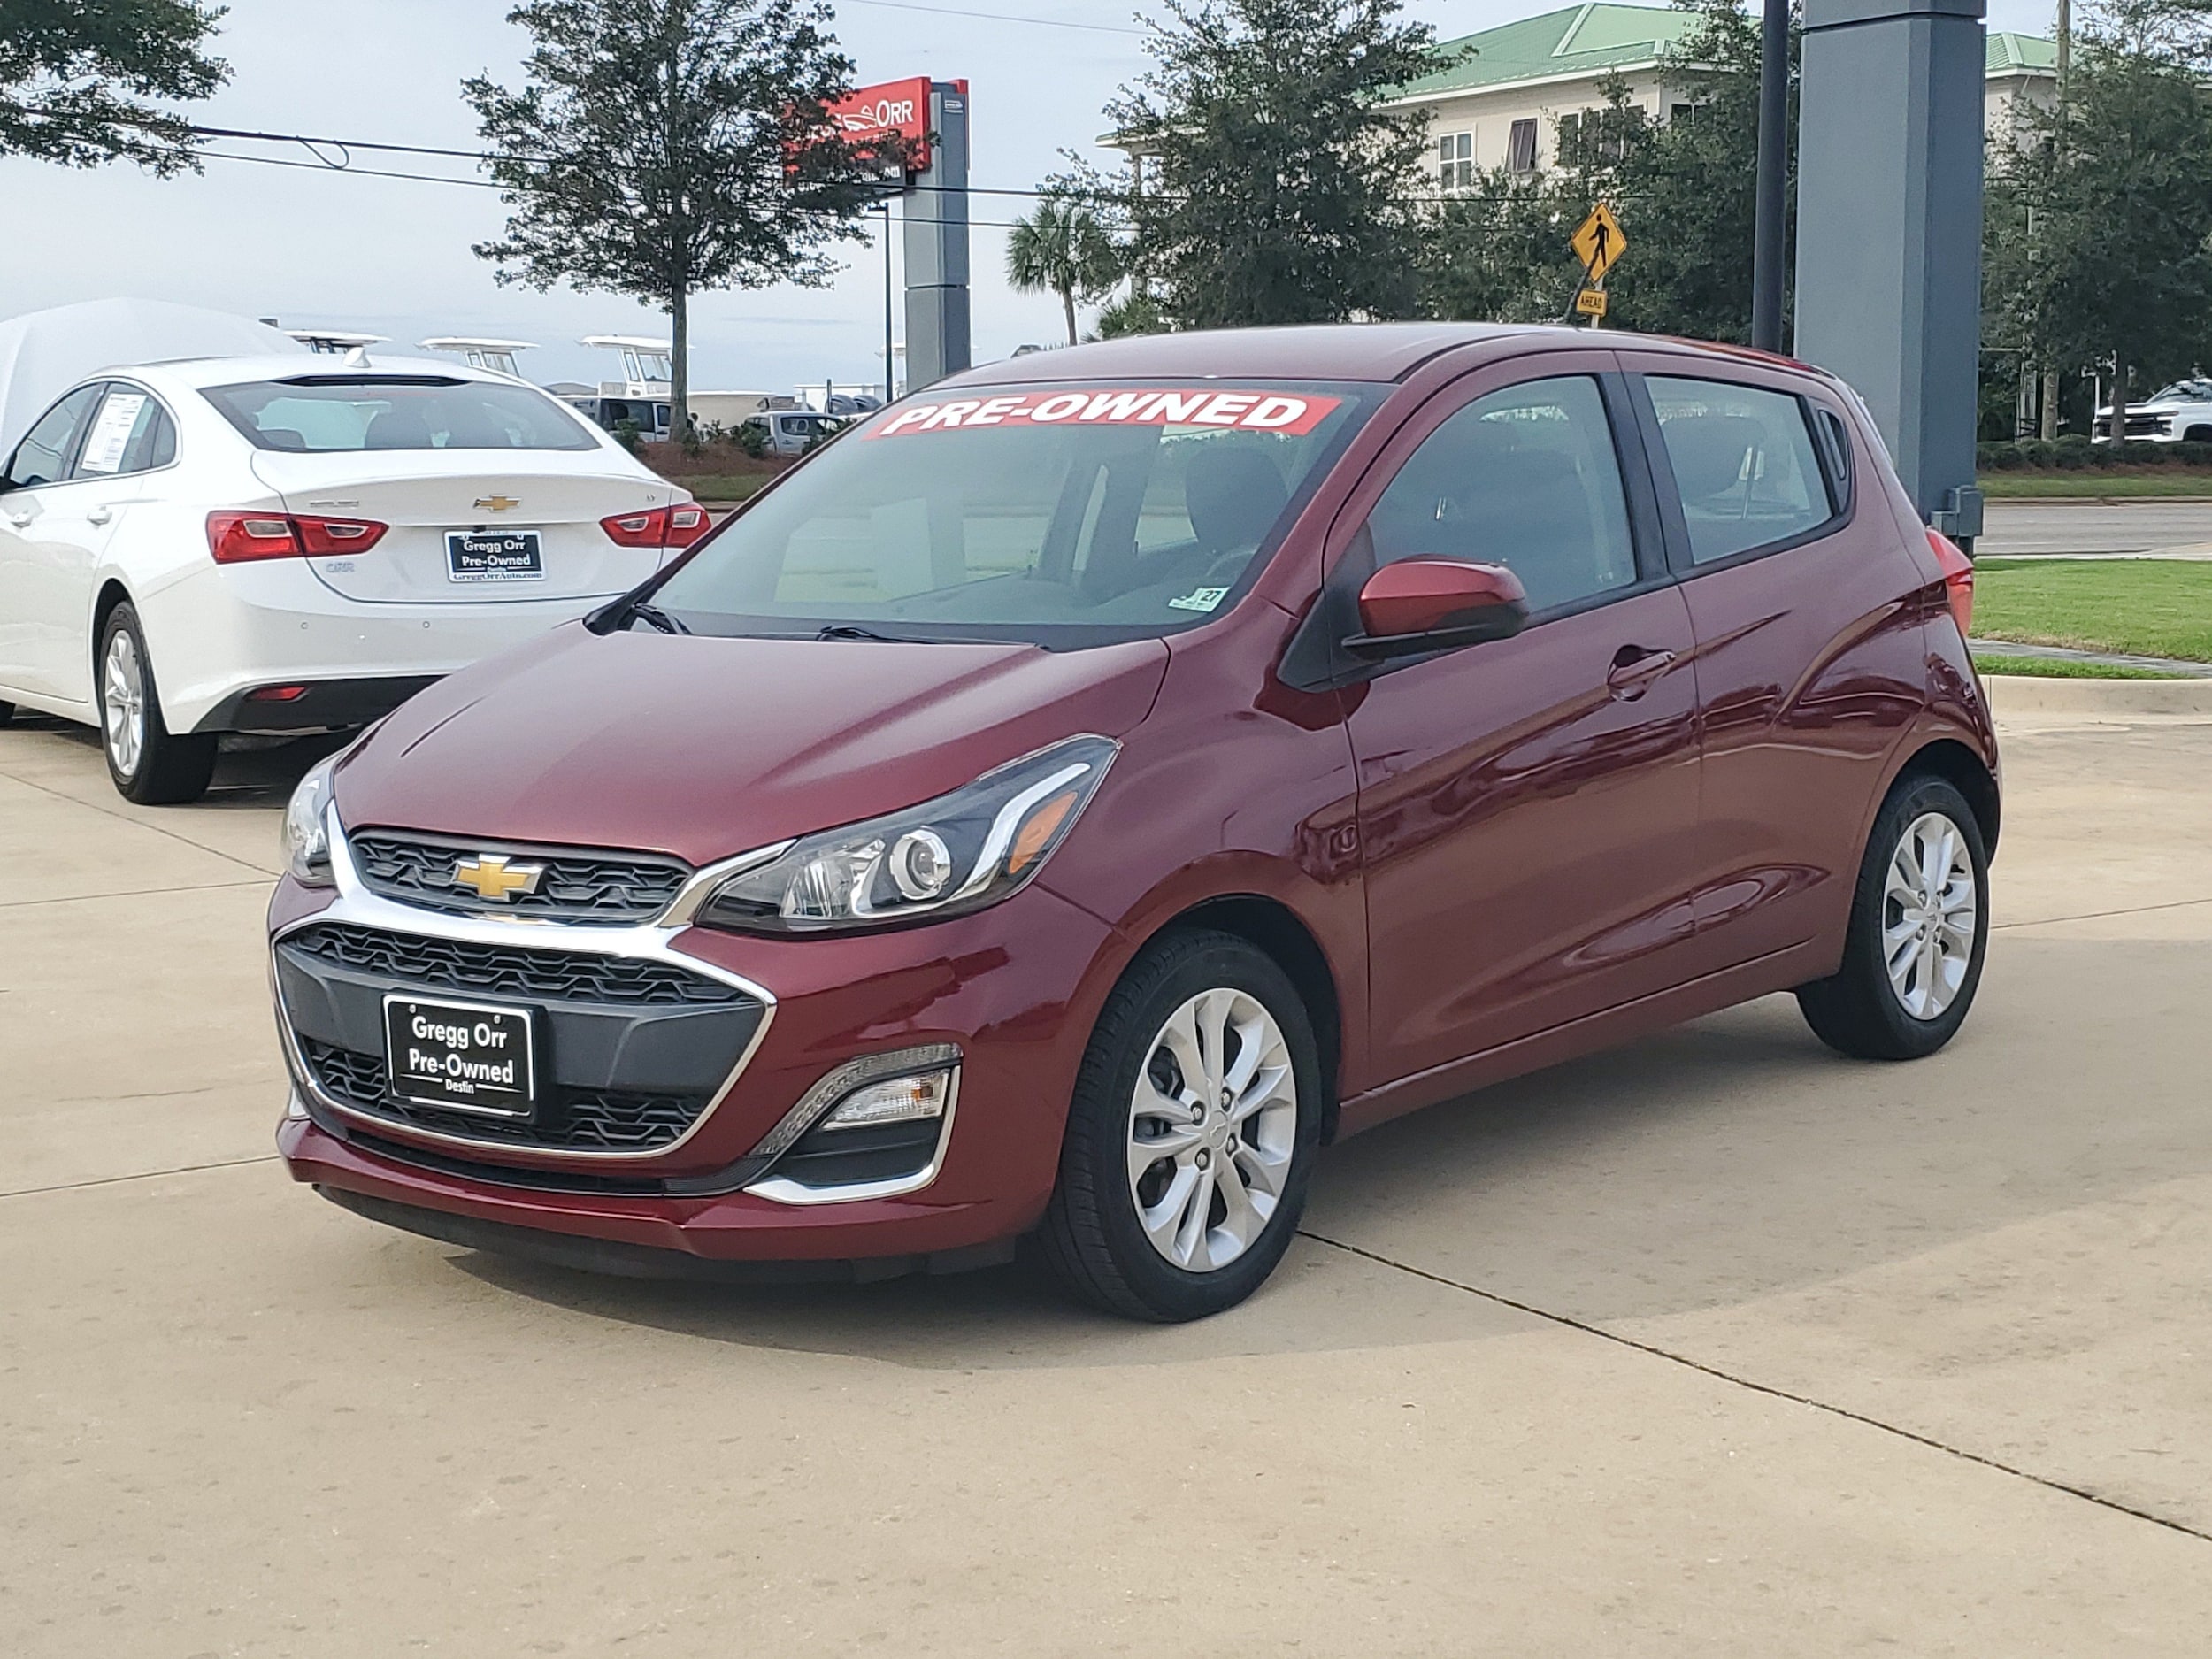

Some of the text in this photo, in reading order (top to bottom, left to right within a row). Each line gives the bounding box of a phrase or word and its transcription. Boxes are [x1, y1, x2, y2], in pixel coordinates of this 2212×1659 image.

[876, 99, 914, 127] ORR
[1580, 295, 1602, 309] AHEAD
[879, 392, 1308, 436] PRE-OWNED
[464, 539, 526, 553] Gregg Orr
[461, 553, 531, 566] Pre-Owned
[411, 1015, 508, 1050] Gregg Orr
[408, 1048, 514, 1084] Pre-Owned
[445, 1078, 475, 1094] Destin
